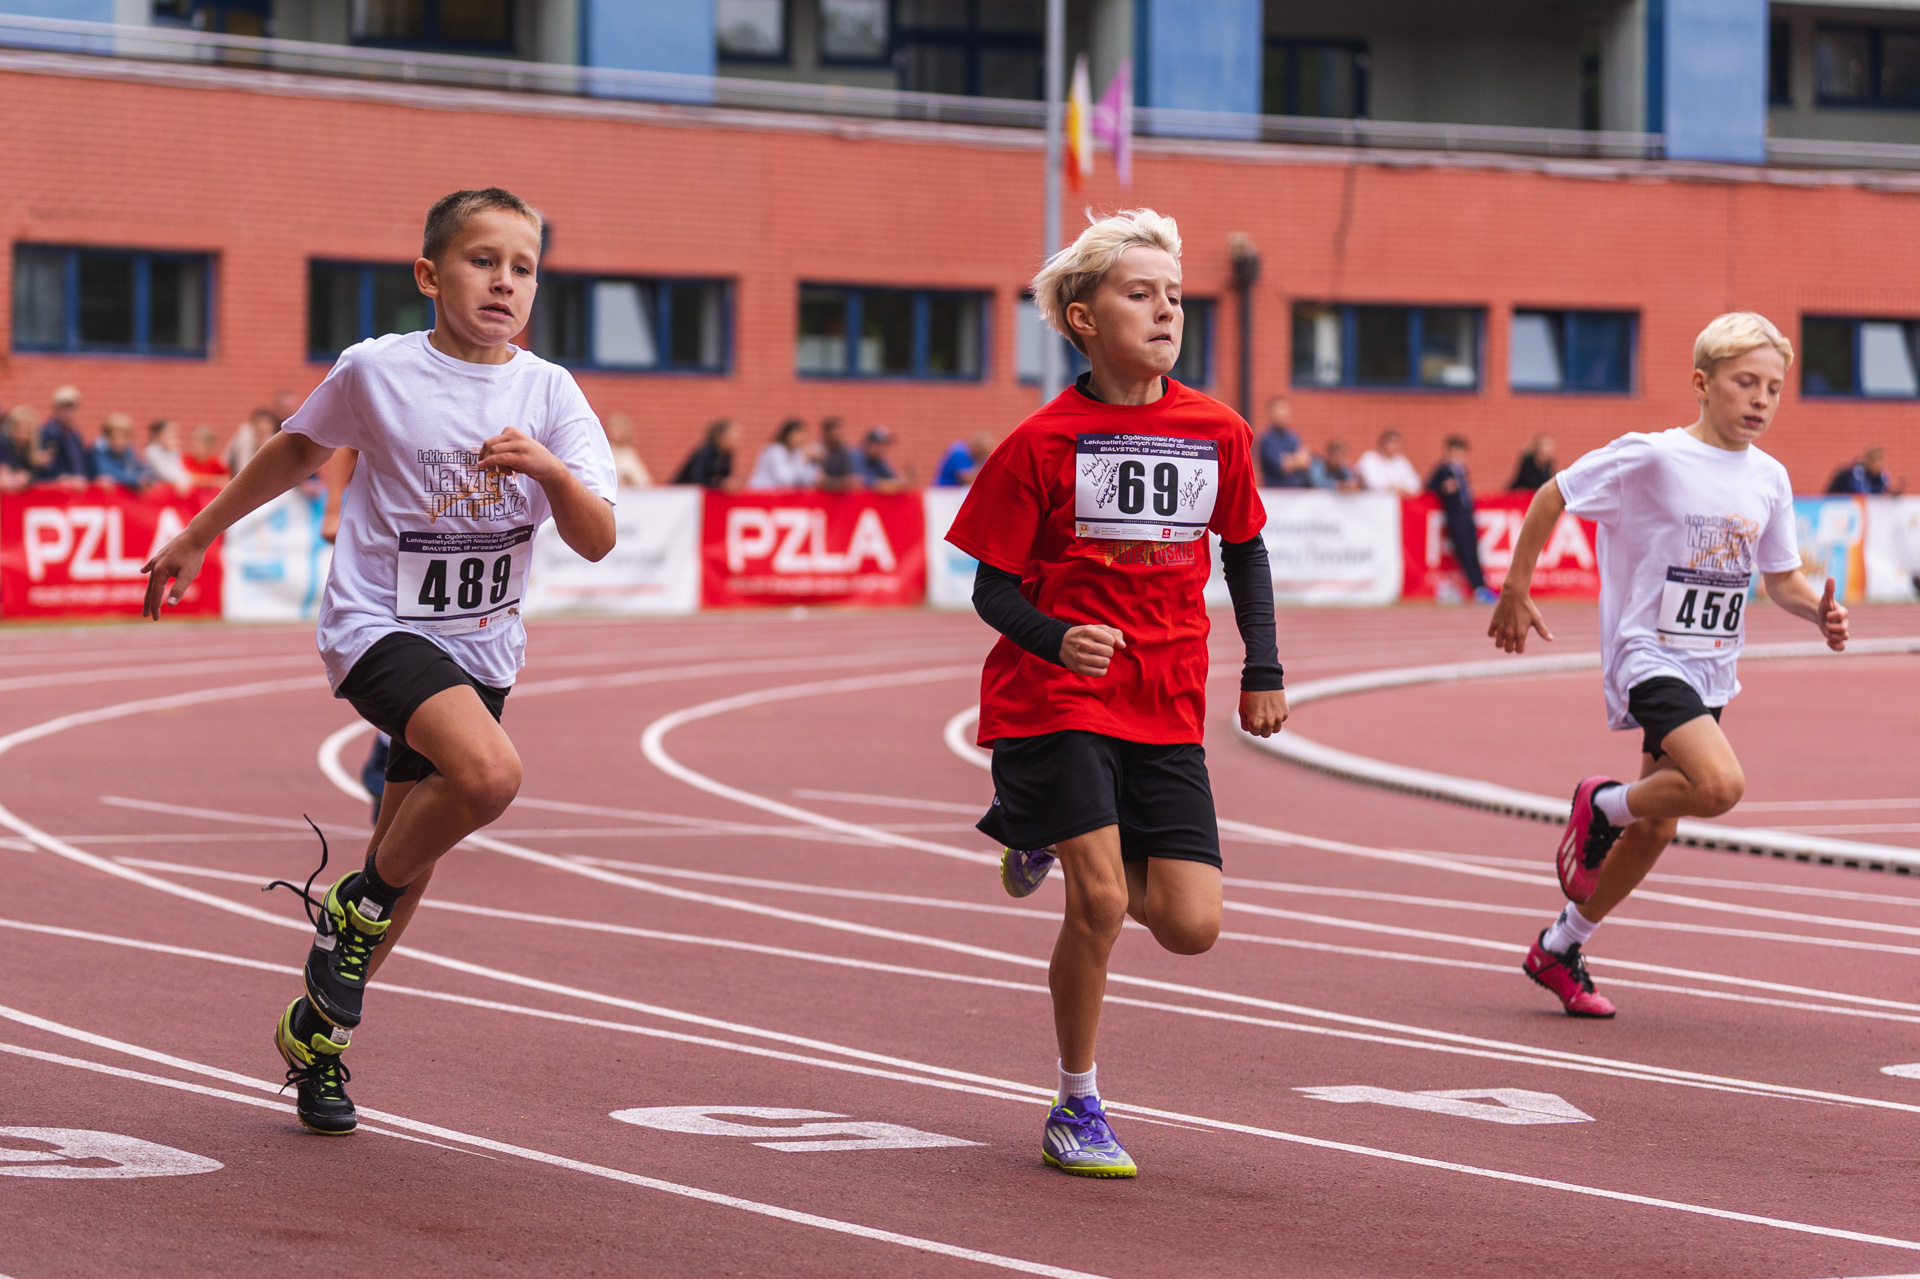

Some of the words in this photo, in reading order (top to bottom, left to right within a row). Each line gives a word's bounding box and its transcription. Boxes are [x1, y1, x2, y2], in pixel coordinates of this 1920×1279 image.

[1083, 439, 1151, 447] Lekkoatletycznych
[1176, 443, 1214, 451] Olimpijskich
[1122, 434, 1168, 442] Ogólnopolski
[1150, 448, 1180, 456] września
[424, 464, 517, 498] Nadzieje
[1119, 460, 1179, 516] 69
[432, 492, 527, 521] Olimpijskie
[406, 537, 472, 546] Lekkoatletycznych
[444, 533, 492, 541] Ogólnopolski
[726, 507, 896, 574] PZLA
[418, 554, 511, 612] 489
[1676, 589, 1743, 632] 458
[1291, 1085, 1596, 1125] 4
[608, 1105, 990, 1153] 5
